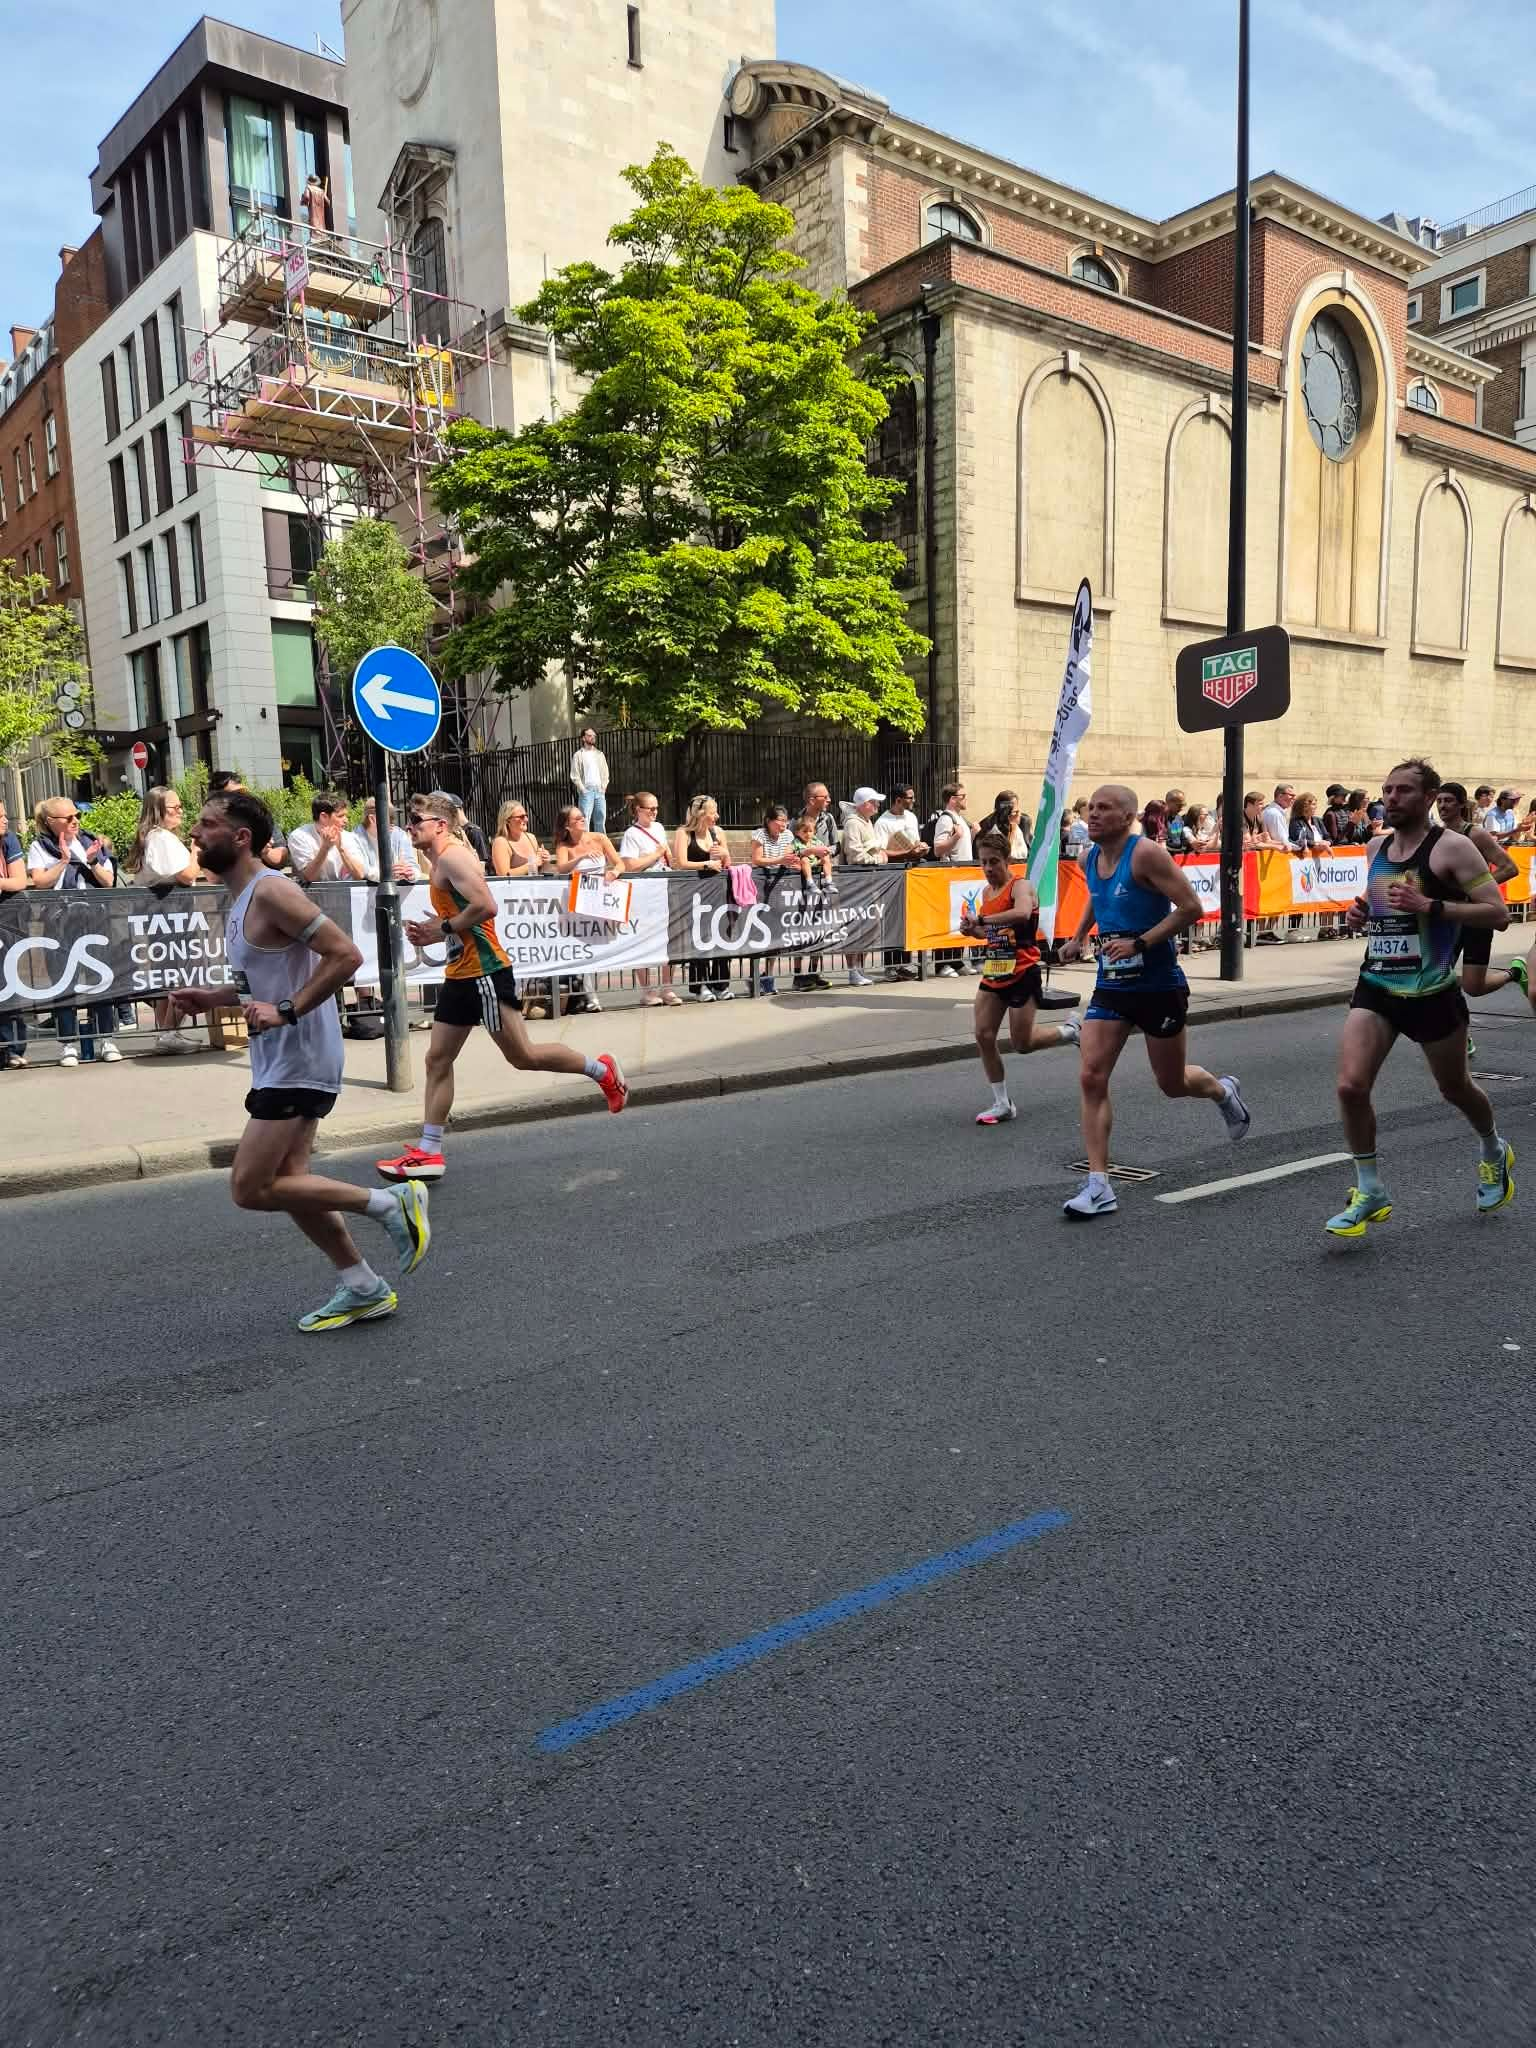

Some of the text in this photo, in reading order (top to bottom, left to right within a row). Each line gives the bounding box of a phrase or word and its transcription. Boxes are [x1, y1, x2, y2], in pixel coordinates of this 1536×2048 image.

[1206, 652, 1252, 676] TAG
[1205, 673, 1254, 703] HEUER
[1312, 865, 1358, 884] Voltarol
[504, 898, 563, 915] TATA
[781, 903, 885, 928] CONSULTANCY
[128, 911, 210, 936] TATA
[504, 919, 639, 940] CONSULTANCY
[781, 926, 849, 948] SERVICES
[506, 943, 594, 963] SERVICES
[0, 933, 114, 1001] cs
[132, 964, 236, 991] SERVICE
